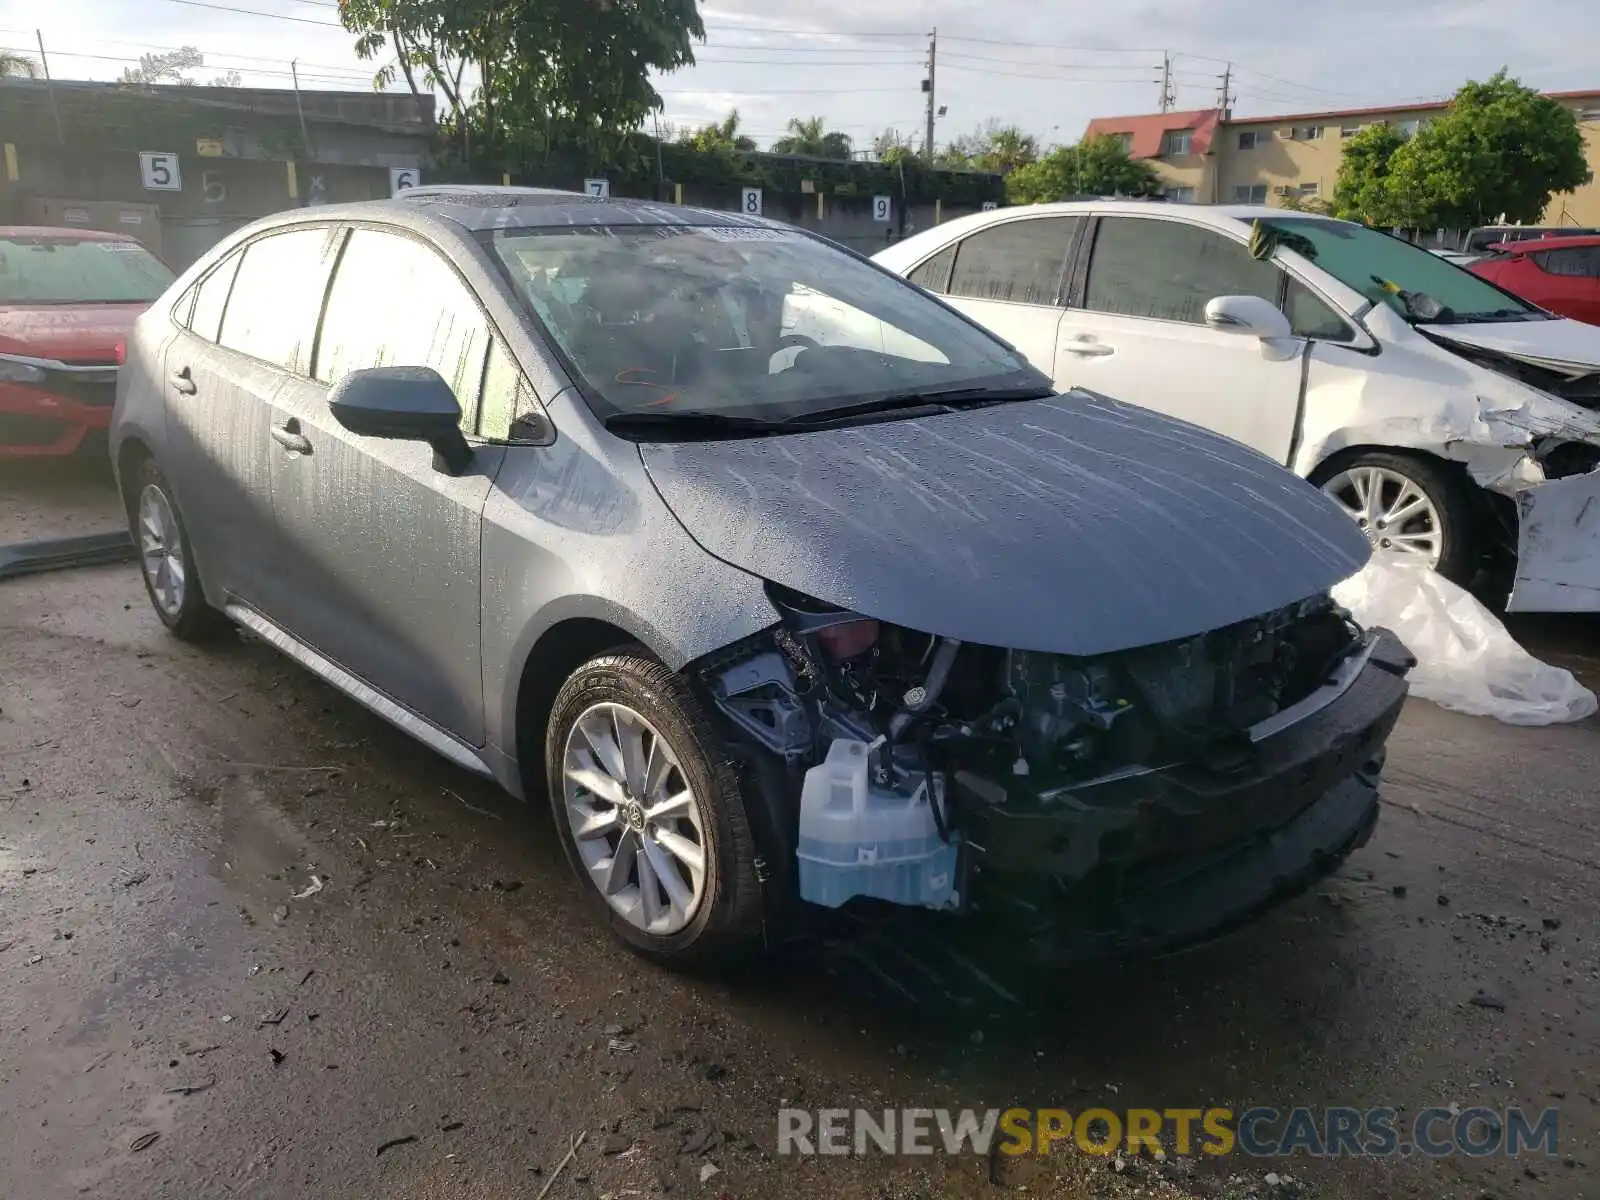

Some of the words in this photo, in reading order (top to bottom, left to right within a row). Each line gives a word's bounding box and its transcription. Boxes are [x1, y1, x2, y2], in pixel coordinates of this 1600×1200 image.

[151, 158, 170, 184] 5
[747, 192, 757, 212] 8
[878, 200, 887, 217] 9
